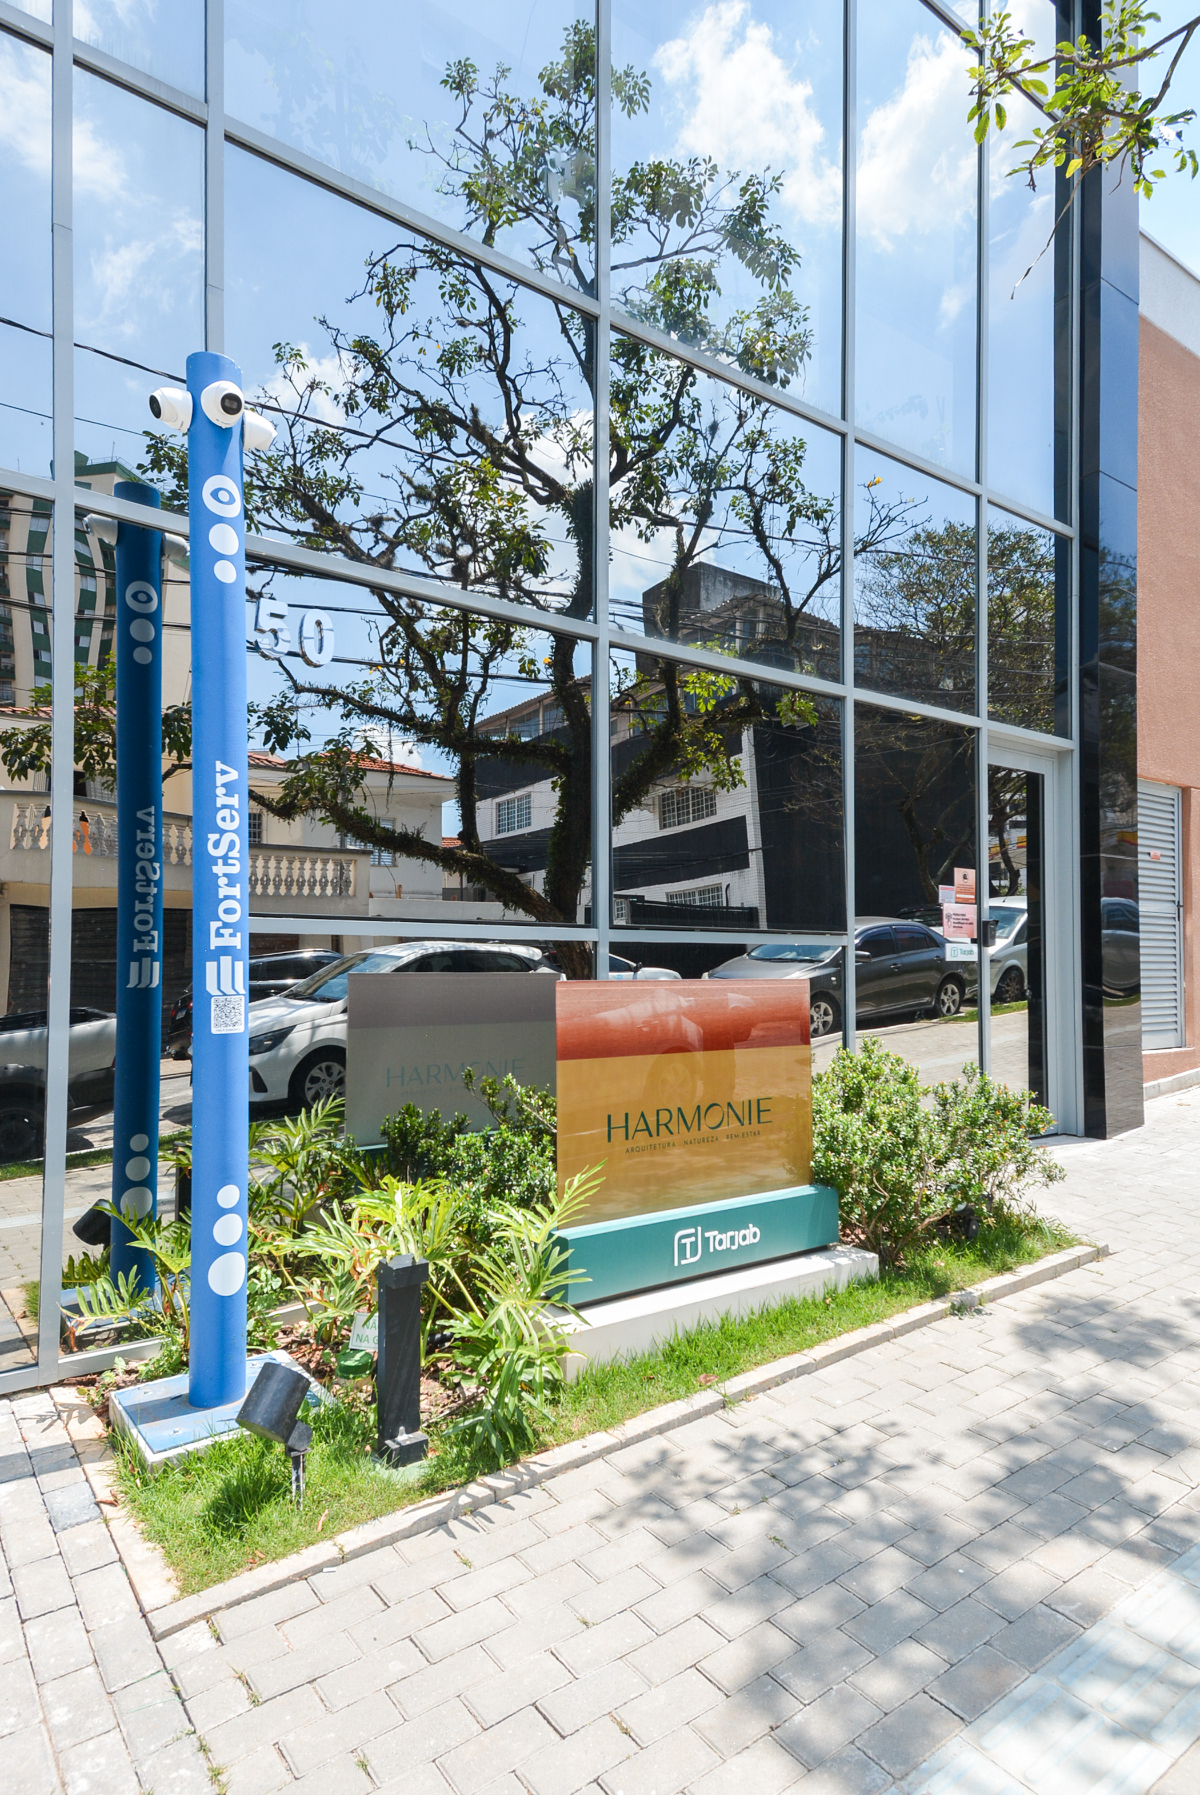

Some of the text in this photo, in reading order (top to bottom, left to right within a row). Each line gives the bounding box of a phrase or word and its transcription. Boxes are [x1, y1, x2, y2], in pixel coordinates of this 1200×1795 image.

[207, 760, 242, 950] FortServ
[607, 1097, 773, 1143] HARMONIE
[625, 1141, 676, 1154] ARQUITETURA
[683, 1136, 719, 1146] NATUREZA
[704, 1223, 761, 1252] Tarjab
[363, 1319, 377, 1330] NÃ
[356, 1333, 370, 1343] NA
